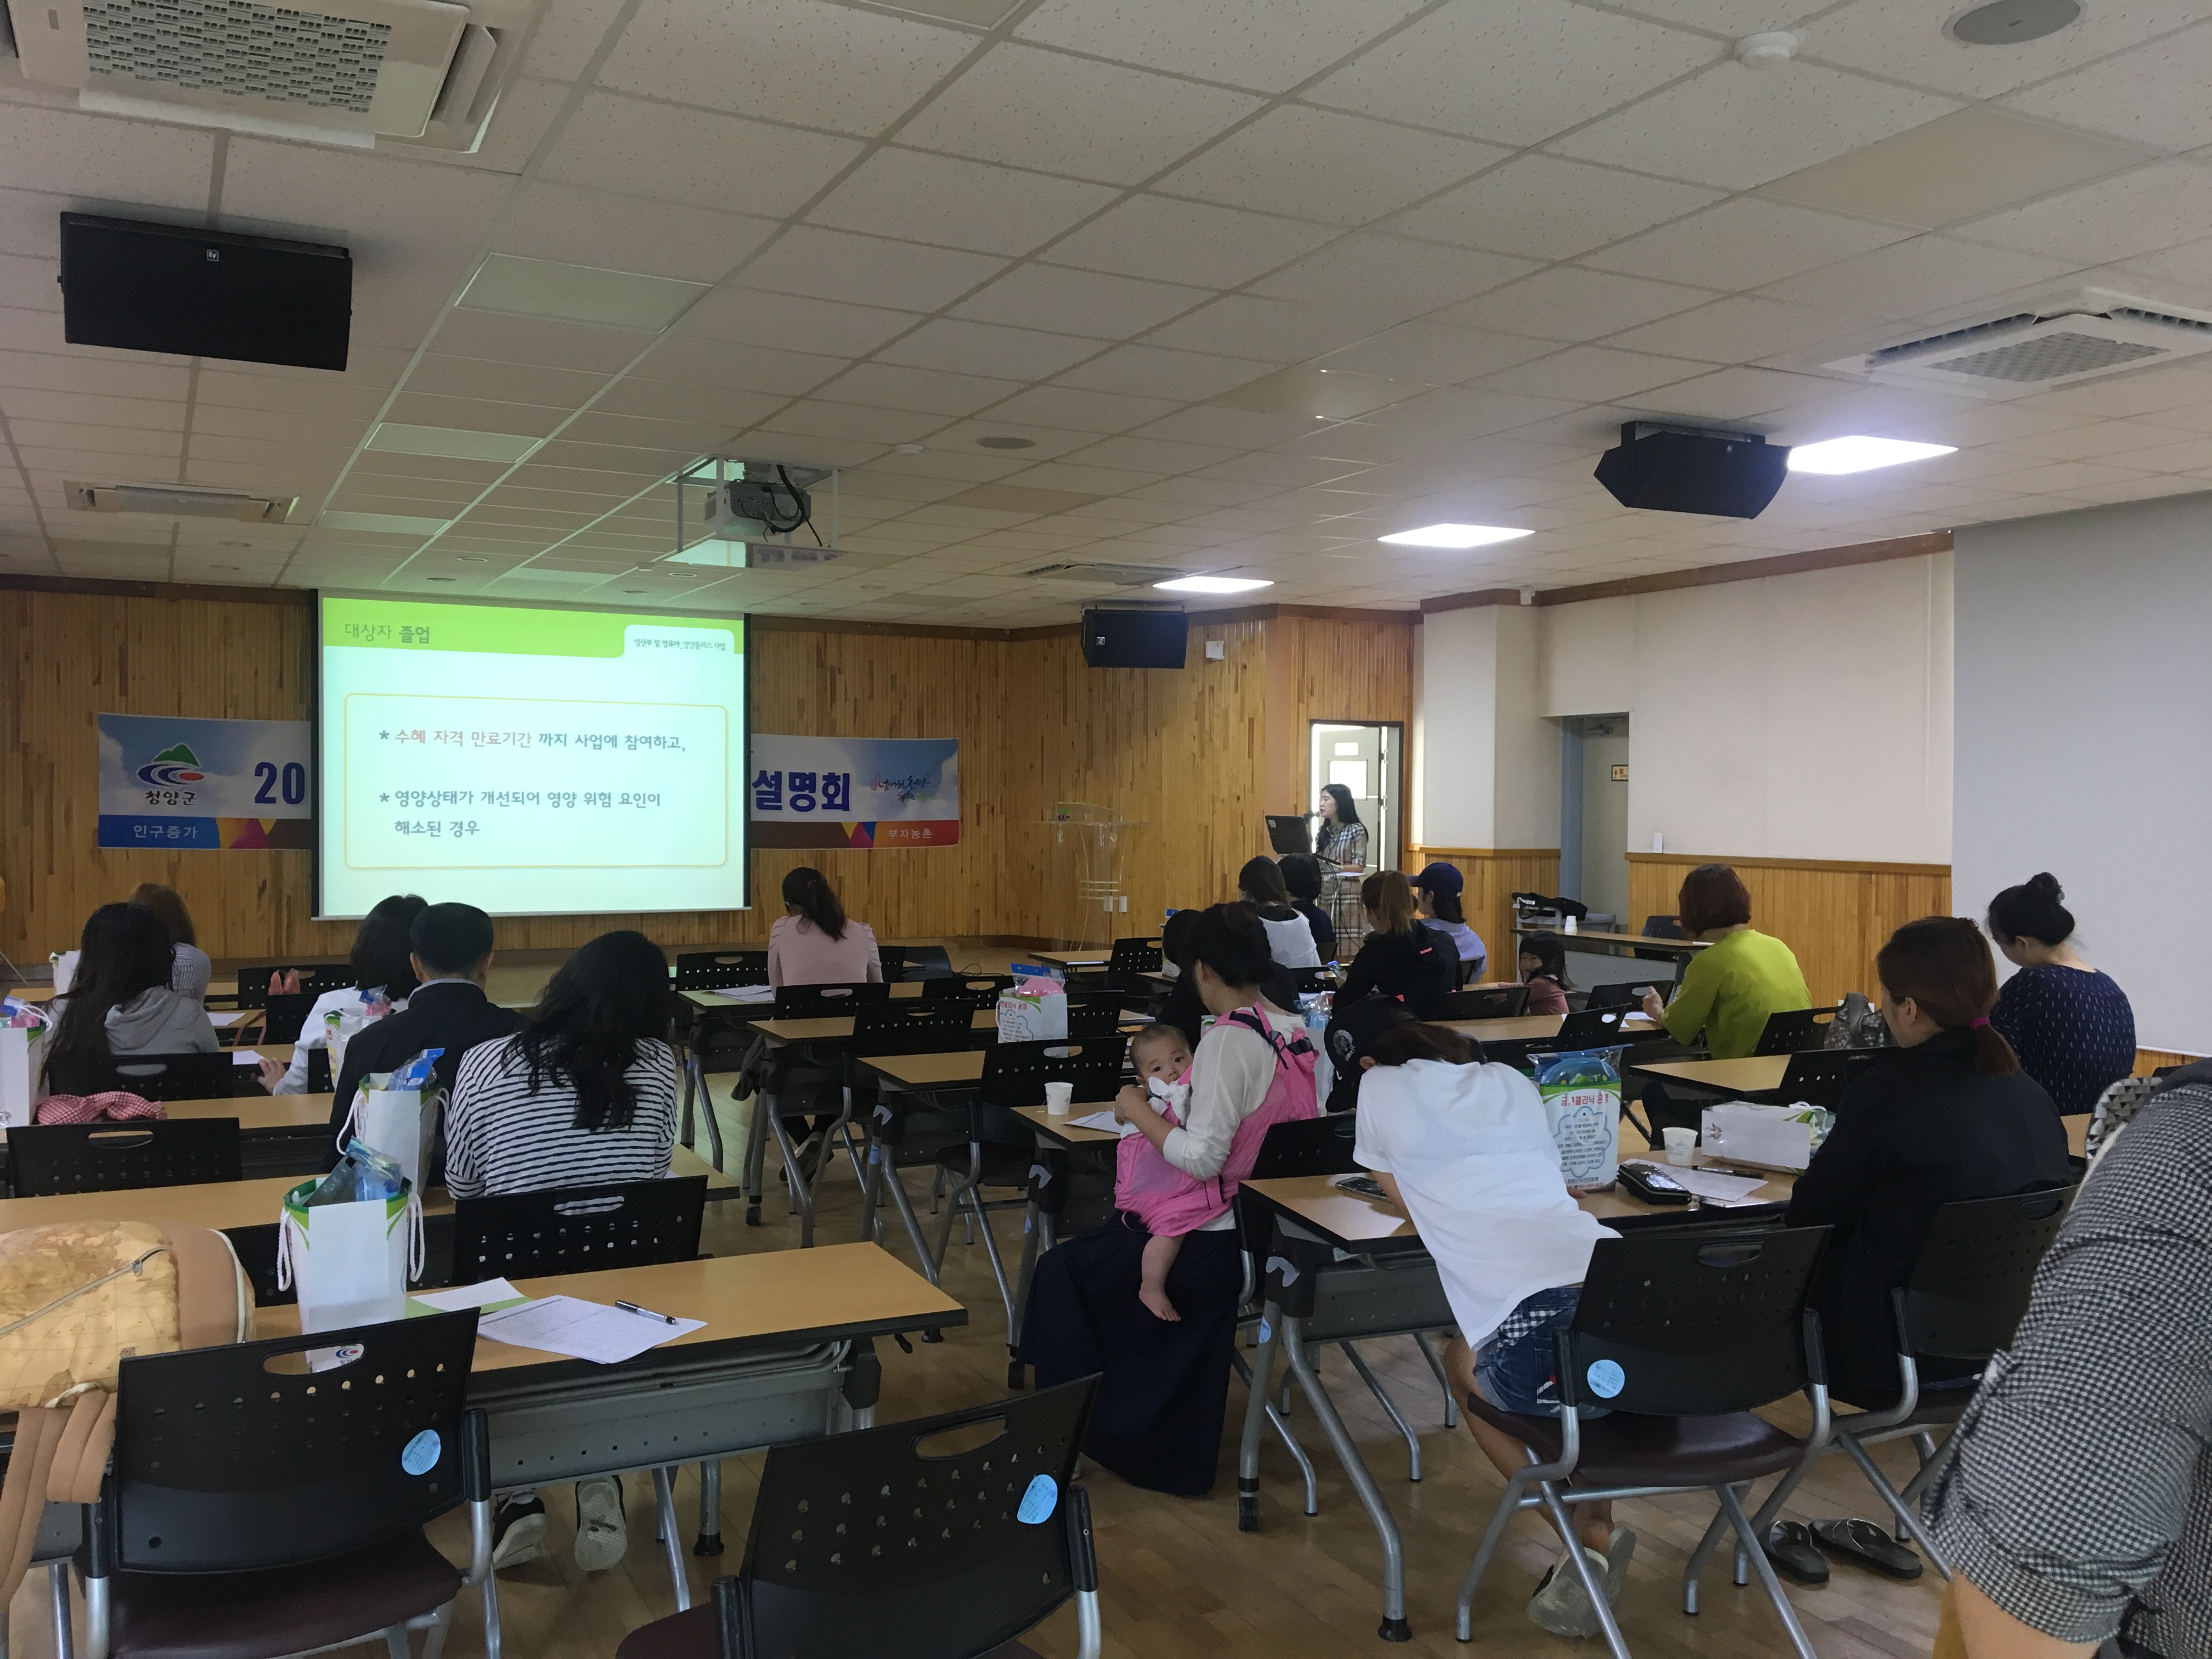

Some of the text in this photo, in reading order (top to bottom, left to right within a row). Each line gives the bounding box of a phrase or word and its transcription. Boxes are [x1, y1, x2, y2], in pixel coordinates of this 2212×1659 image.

[345, 623, 430, 644] 대상자 졸업
[634, 638, 653, 647] 임산부
[654, 639, 661, 648] 및
[713, 642, 726, 651] 사업
[394, 729, 685, 753] 수혜 자격 만료기간 까지 사업에 참여하고,
[254, 761, 305, 805] 20
[752, 770, 850, 812] 설명회
[145, 790, 197, 806] 청양군
[394, 791, 661, 809] 영양상태가 개선되어 영양 위험 요인이
[133, 825, 198, 839] 인구증가
[394, 820, 481, 838] 해소된 경우
[888, 828, 932, 840] 부자농촌
